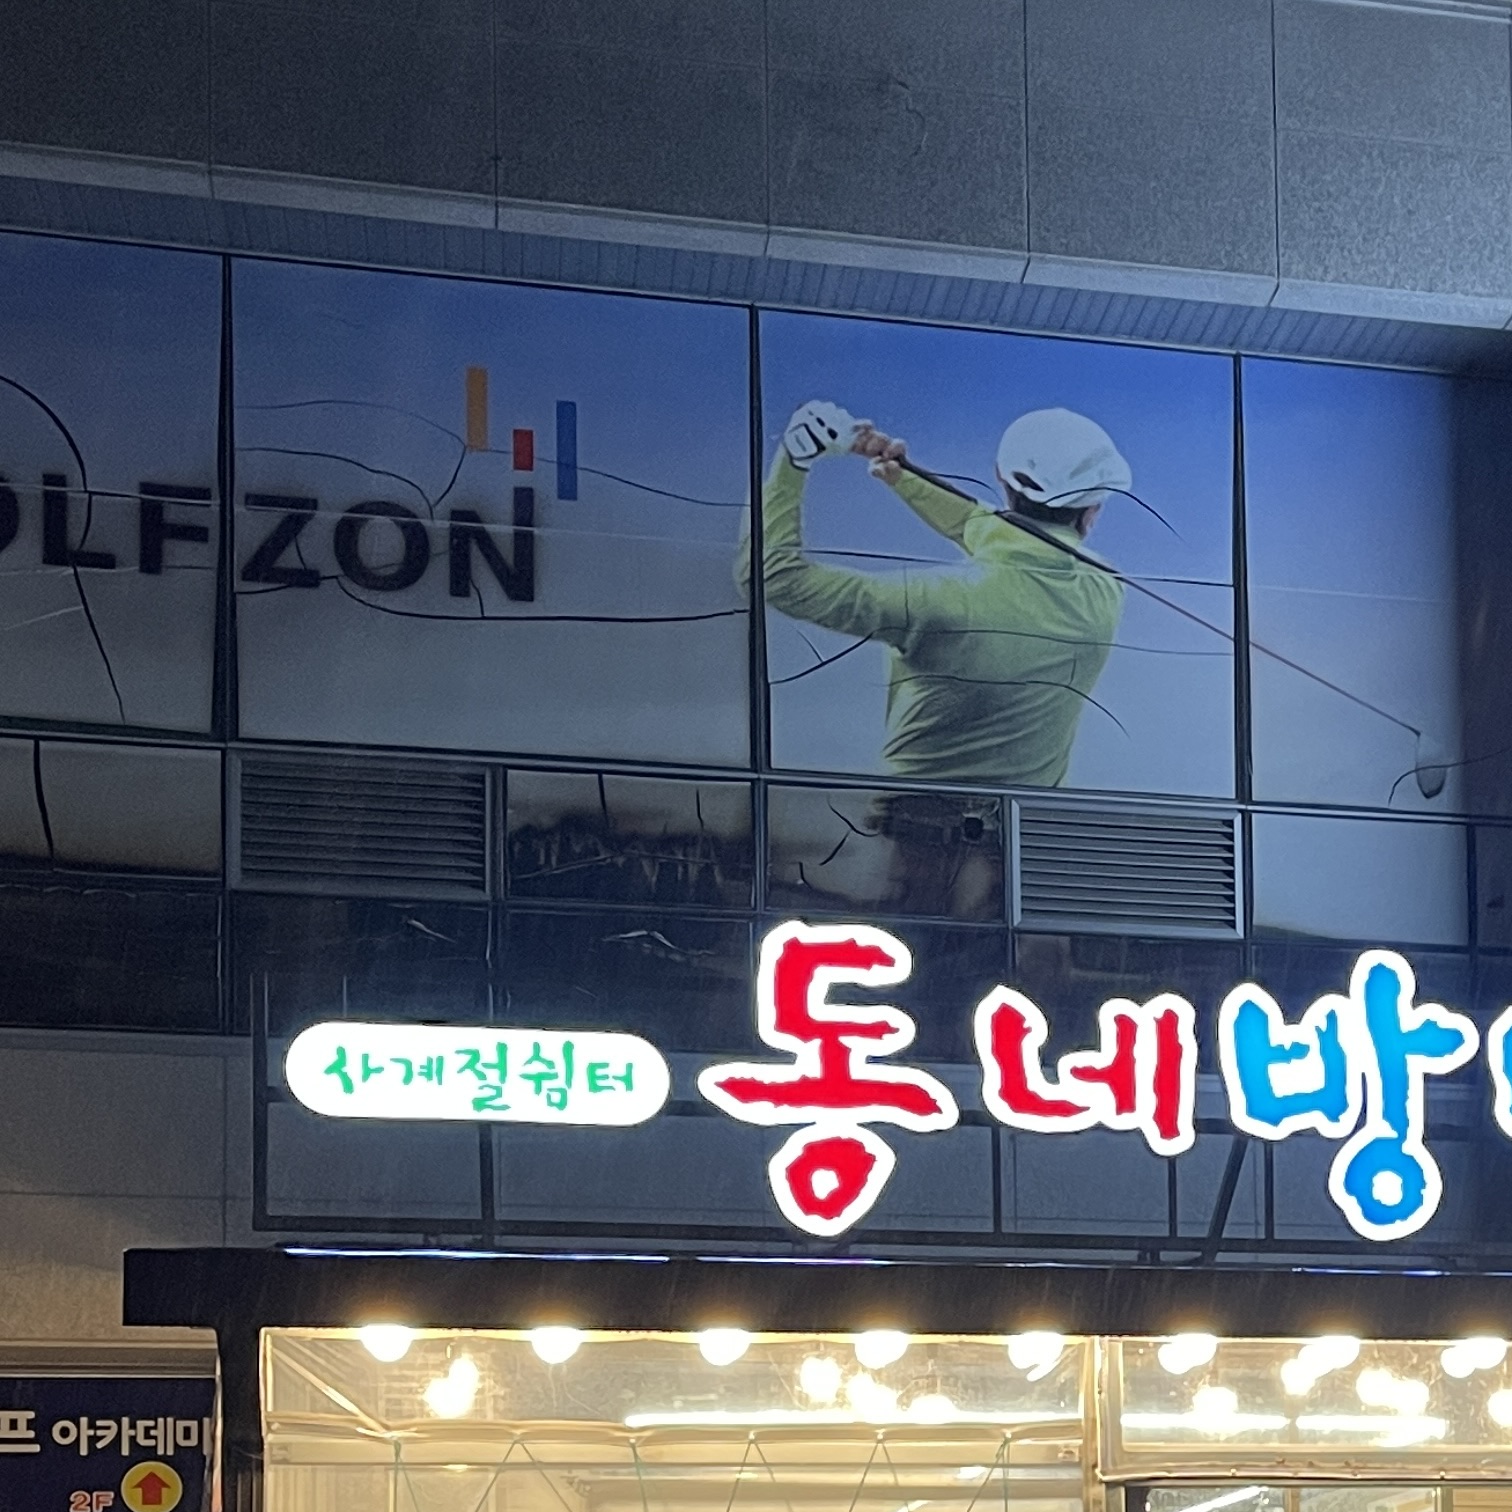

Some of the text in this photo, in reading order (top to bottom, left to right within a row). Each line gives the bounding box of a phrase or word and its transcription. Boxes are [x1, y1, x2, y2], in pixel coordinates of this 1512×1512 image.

[0, 473, 535, 602] LFZON
[323, 1041, 634, 1113] 사계절쉼터
[51, 1416, 213, 1457] 아카데미
